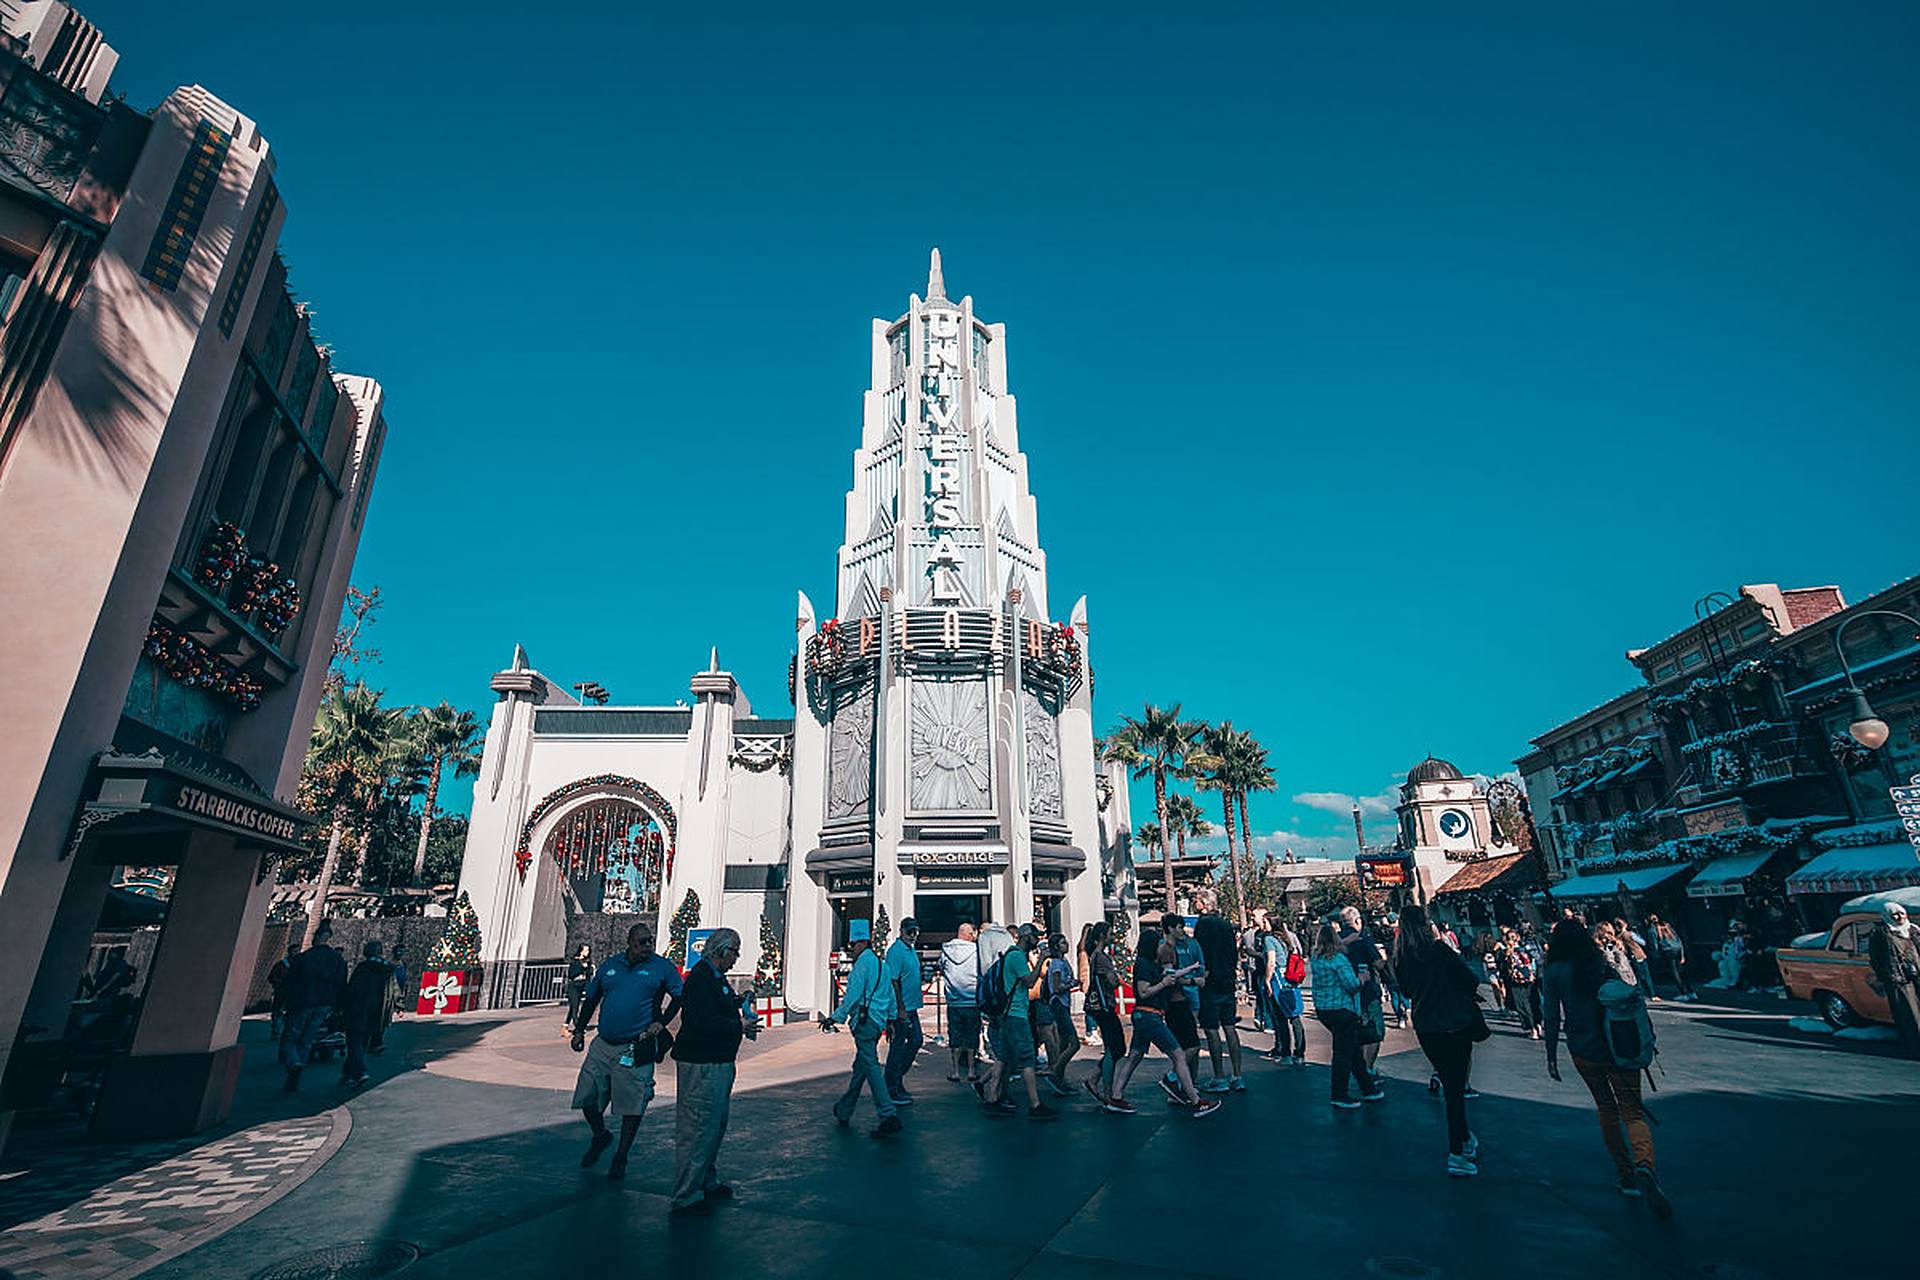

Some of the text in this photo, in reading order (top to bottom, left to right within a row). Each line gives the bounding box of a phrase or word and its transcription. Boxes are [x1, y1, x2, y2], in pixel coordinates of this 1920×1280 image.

[928, 312, 963, 600] UNIVERSAL
[177, 786, 295, 839] STARBUCKS COFFEE
[913, 853, 995, 863] BOX OFFICE
